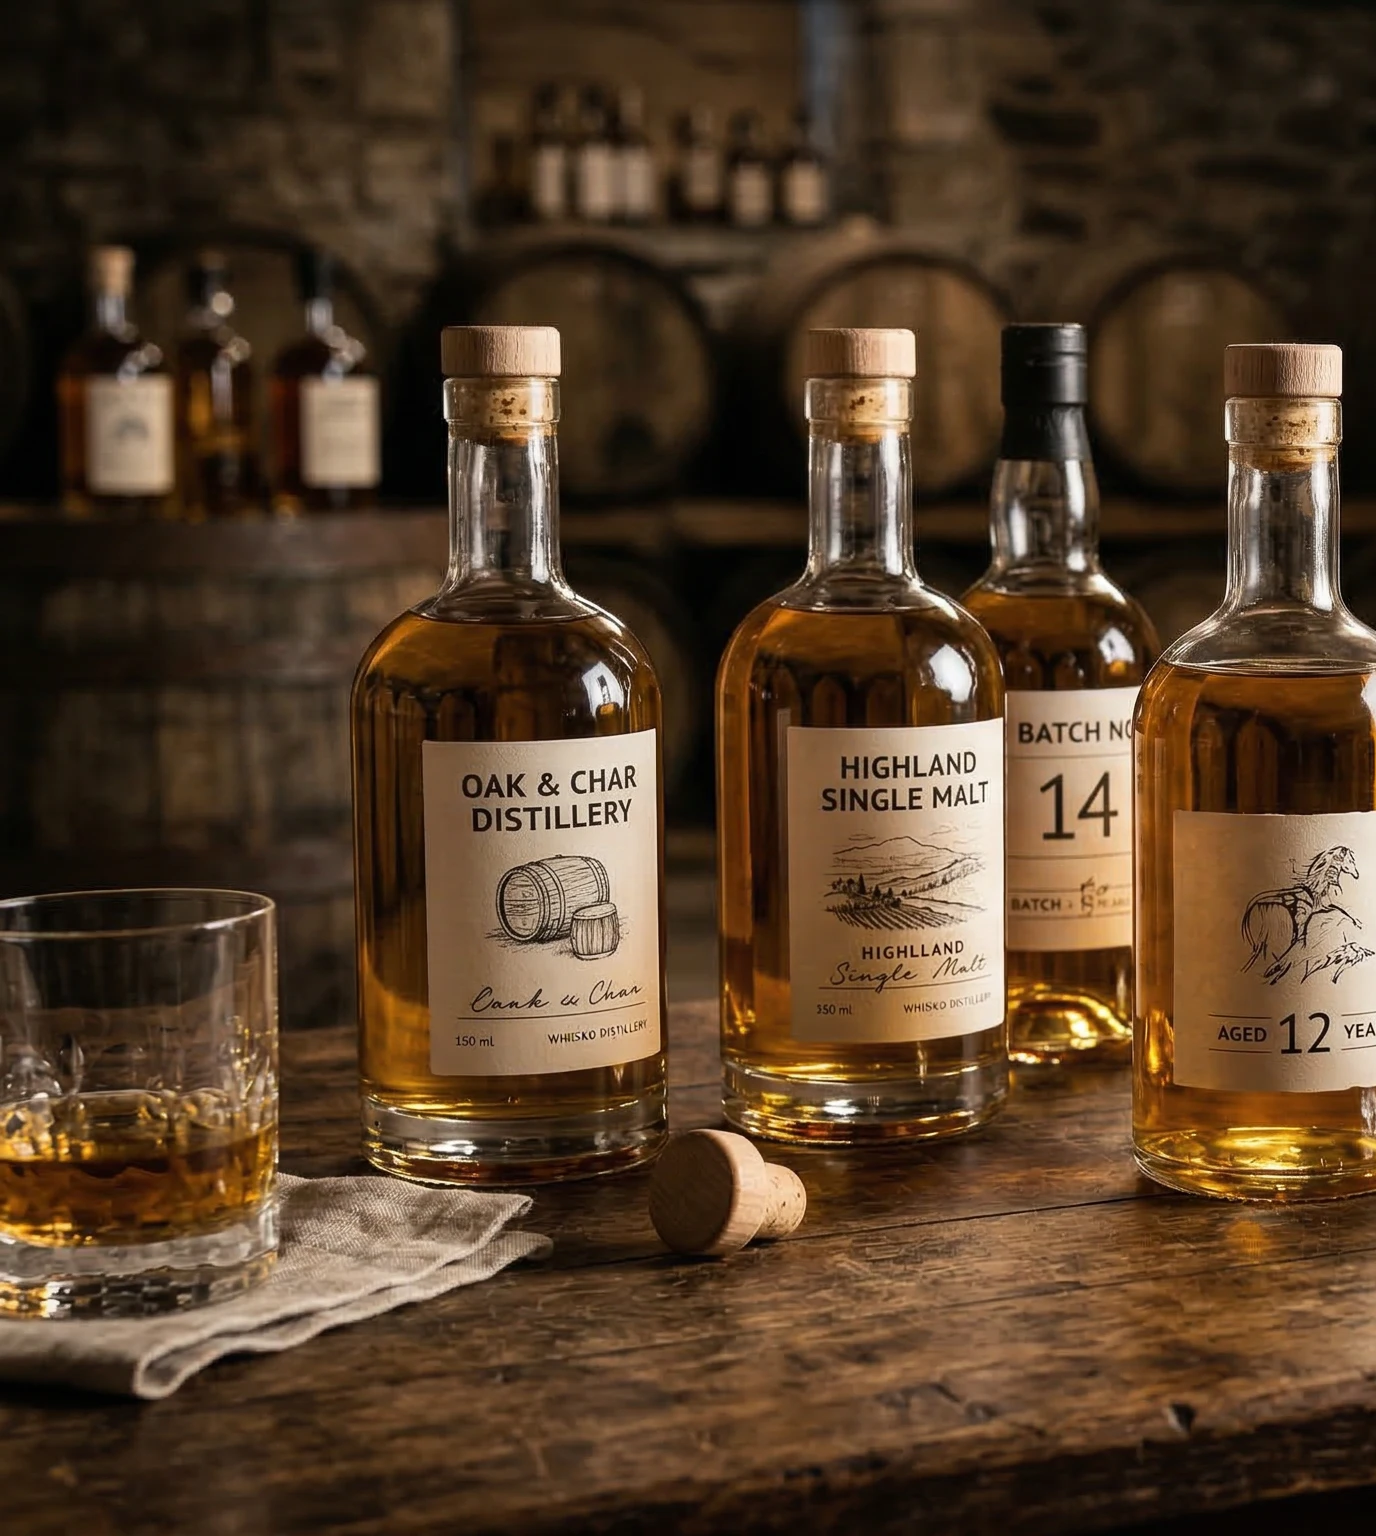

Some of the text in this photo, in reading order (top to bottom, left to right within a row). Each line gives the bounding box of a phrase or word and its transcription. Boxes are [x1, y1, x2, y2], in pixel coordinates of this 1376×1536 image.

[1019, 722, 1100, 743] BATCH
[842, 752, 976, 779] HIGHLAND
[462, 765, 636, 798] OAK & CHAR
[822, 781, 988, 811] SINGLE MALT
[1040, 771, 1118, 840] 14
[472, 799, 632, 832] DISTILLERY
[862, 941, 963, 960] HIGHLLAND
[830, 954, 986, 993] Single Malt
[839, 1005, 852, 1015] ml
[904, 1002, 946, 1013] WHISKO
[456, 1036, 494, 1046] 150 ml
[1218, 1025, 1267, 1042] AGED
[1280, 1013, 1330, 1054] 12
